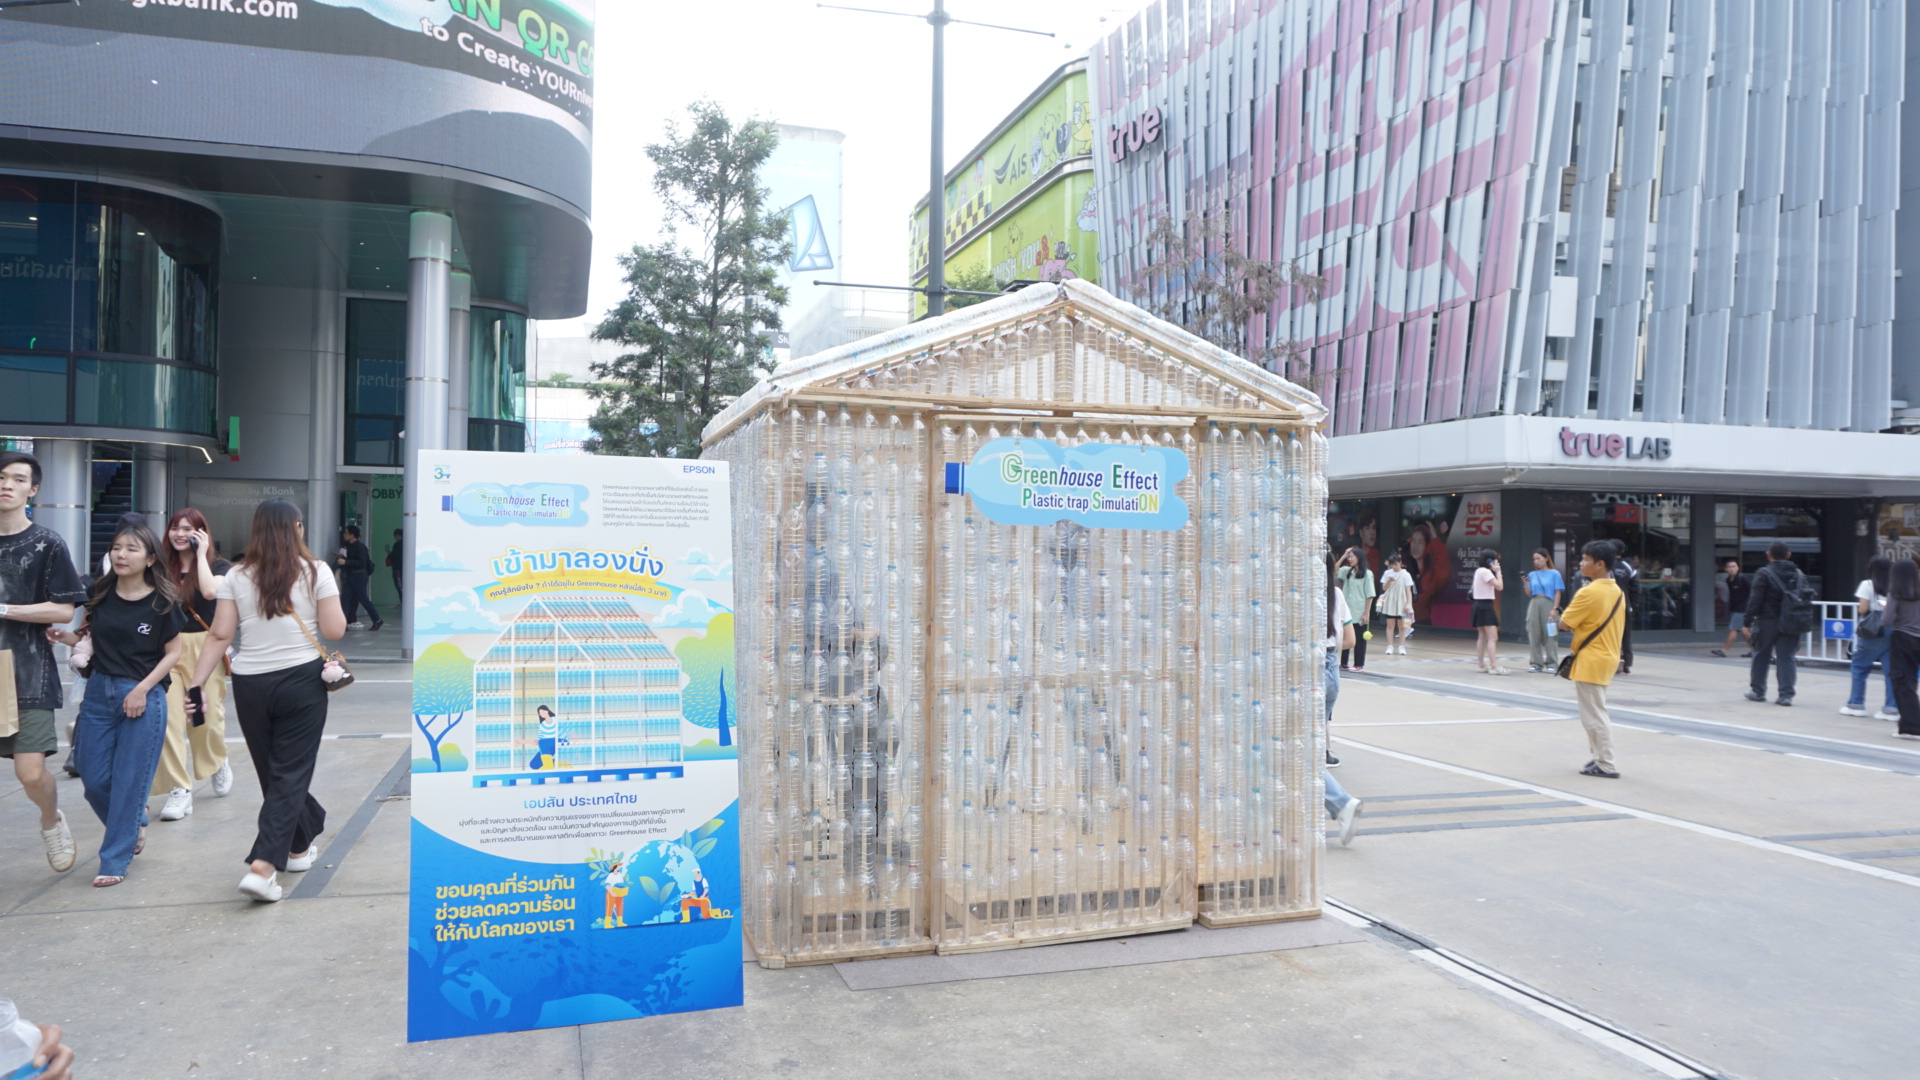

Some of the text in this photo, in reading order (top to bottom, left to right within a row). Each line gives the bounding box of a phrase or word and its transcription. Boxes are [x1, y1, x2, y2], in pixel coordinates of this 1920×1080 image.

[420, 17, 449, 42] to
[457, 32, 530, 77] Create
[517, 8, 570, 64] QR
[1107, 106, 1163, 163] true
[1009, 152, 1028, 186] AIS
[1559, 426, 1672, 459] true LAB
[683, 465, 715, 474] EPSON
[1002, 453, 1159, 490] Greenhouse Effect
[217, 497, 267, 506] INFORMAT
[262, 485, 295, 496] KBank
[372, 488, 403, 499] OBBY
[475, 488, 569, 508] Greenhouse Effect
[1023, 488, 1159, 512] Plastic trap SimulatiON
[487, 505, 511, 516] Plastic
[513, 509, 527, 518] trap
[1467, 501, 1494, 515] true
[1464, 516, 1495, 536] 5G
[493, 546, 664, 577] เข้ามาลองนั่ง
[577, 580, 618, 588] Greenhouse
[524, 792, 638, 809] เอปสัน ประเทศไทย
[609, 829, 647, 837] Greenhouse
[435, 872, 575, 901] ขอบคุณที่ร่วมกัน
[435, 894, 576, 920] ช่วยลดความร้อน
[435, 918, 575, 942] ให้กับโลกของเรา
